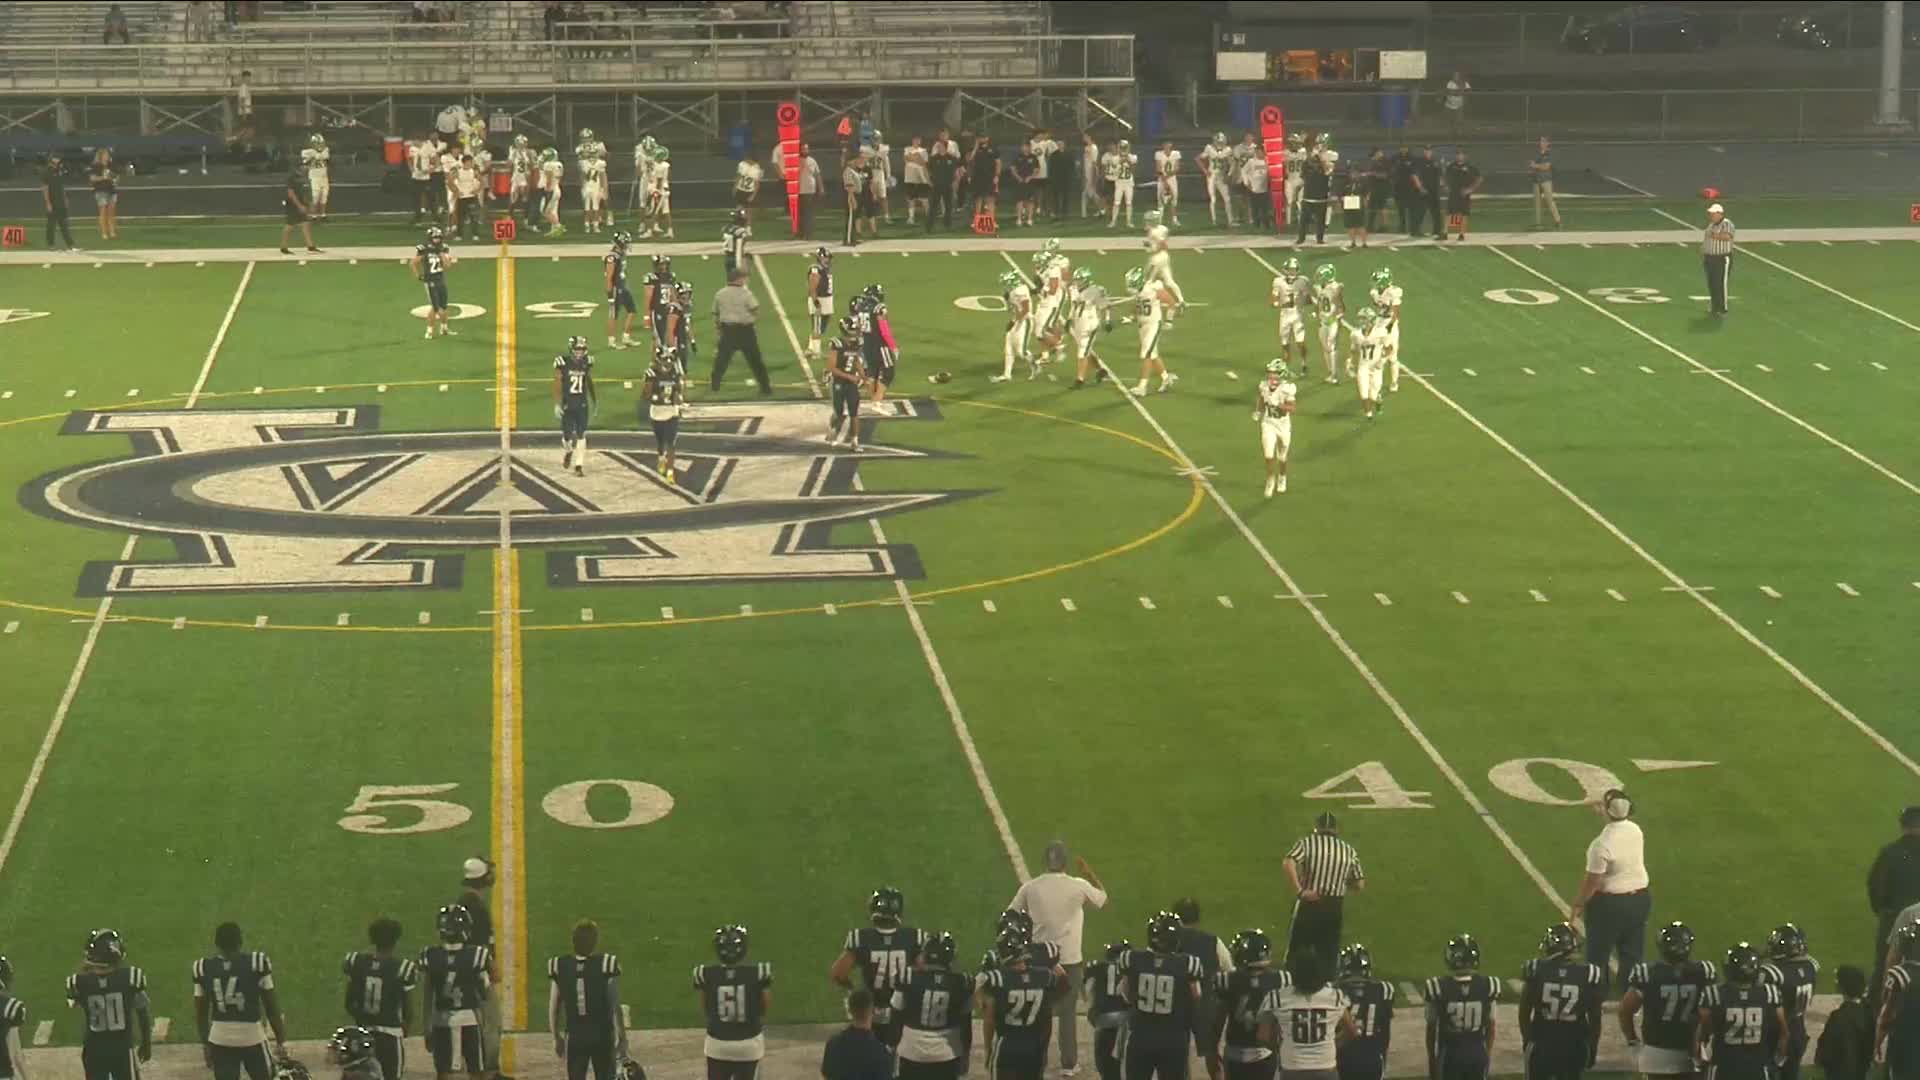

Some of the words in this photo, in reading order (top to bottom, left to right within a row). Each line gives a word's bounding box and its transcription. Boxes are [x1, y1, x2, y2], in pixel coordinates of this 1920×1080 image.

[4, 228, 22, 246] 40
[496, 223, 513, 239] 50
[570, 375, 583, 394] 21
[870, 950, 906, 989] 70
[213, 976, 245, 1012] 14
[364, 976, 383, 1015] 0
[576, 978, 587, 1015] 1
[718, 985, 746, 1022] 61
[920, 989, 950, 1027] 18
[1005, 988, 1043, 1027] 27
[1138, 973, 1175, 1014] 99
[1542, 982, 1579, 1021] 52
[1659, 984, 1697, 1021] 77
[1292, 1008, 1327, 1044] 66
